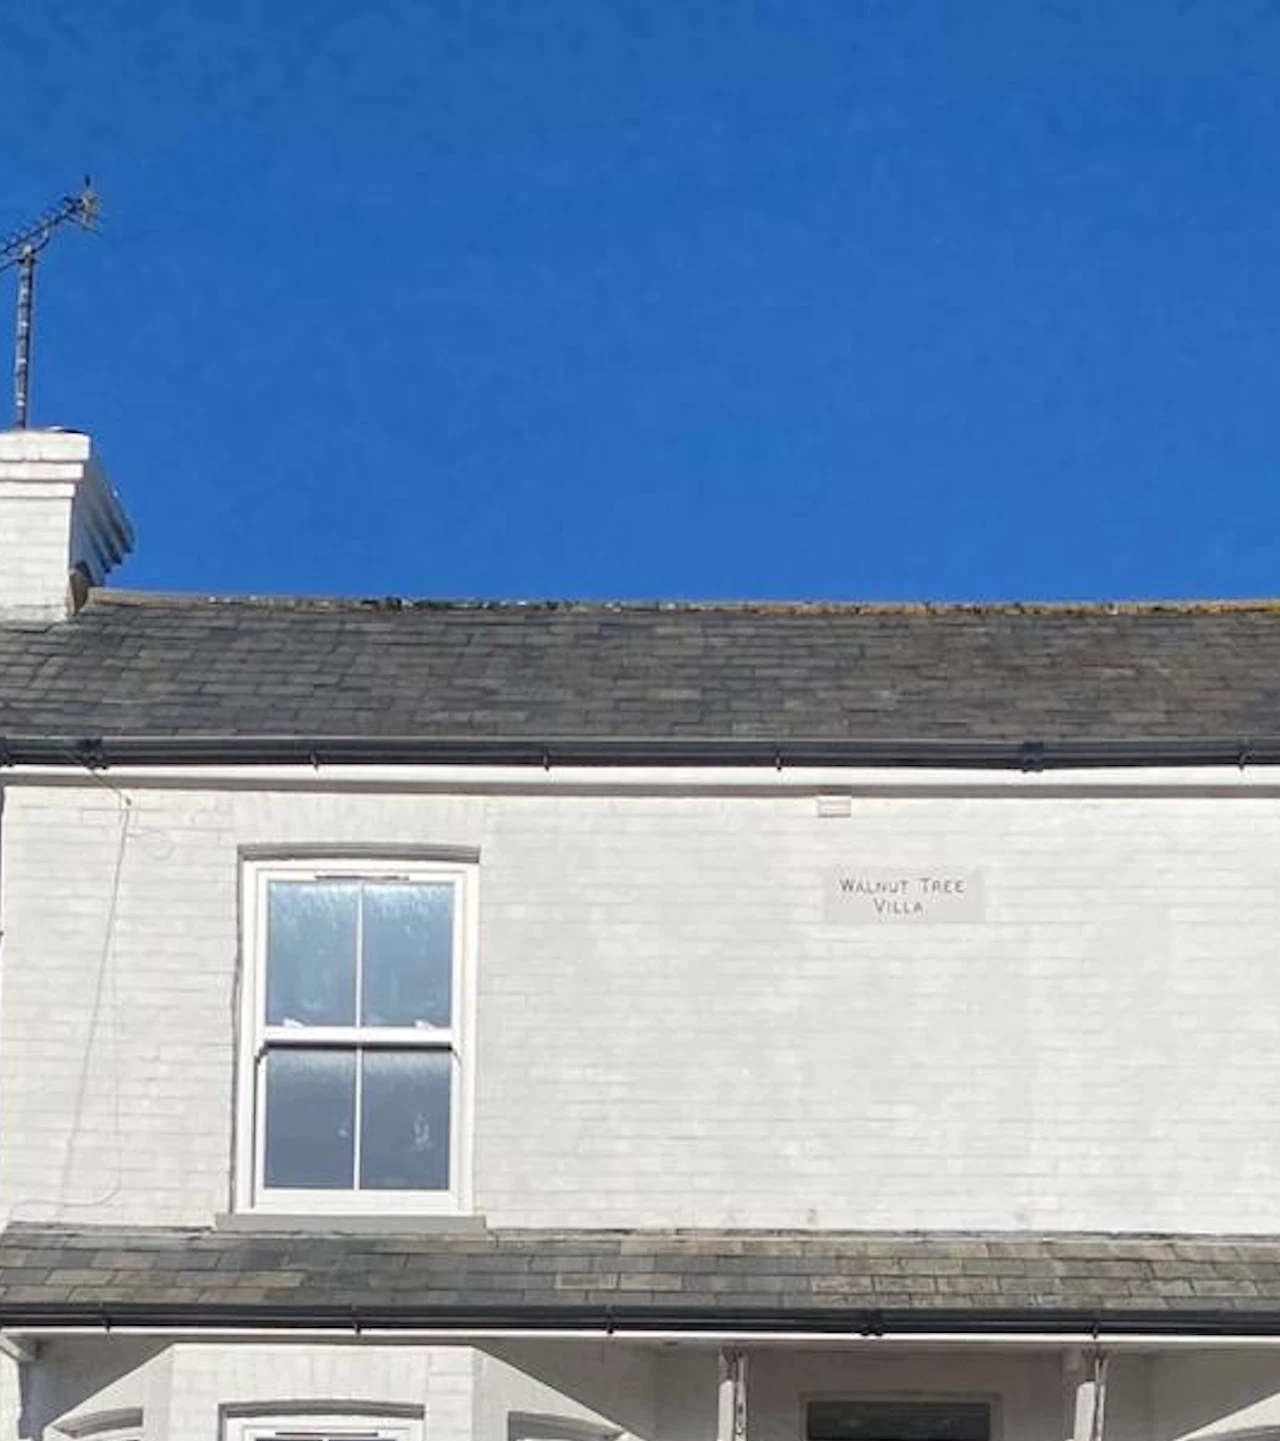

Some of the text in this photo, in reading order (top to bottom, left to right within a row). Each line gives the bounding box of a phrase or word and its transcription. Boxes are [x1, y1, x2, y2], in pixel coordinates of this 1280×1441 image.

[840, 878, 965, 895] WALNUT TREE
[874, 897, 924, 914] VILLA
